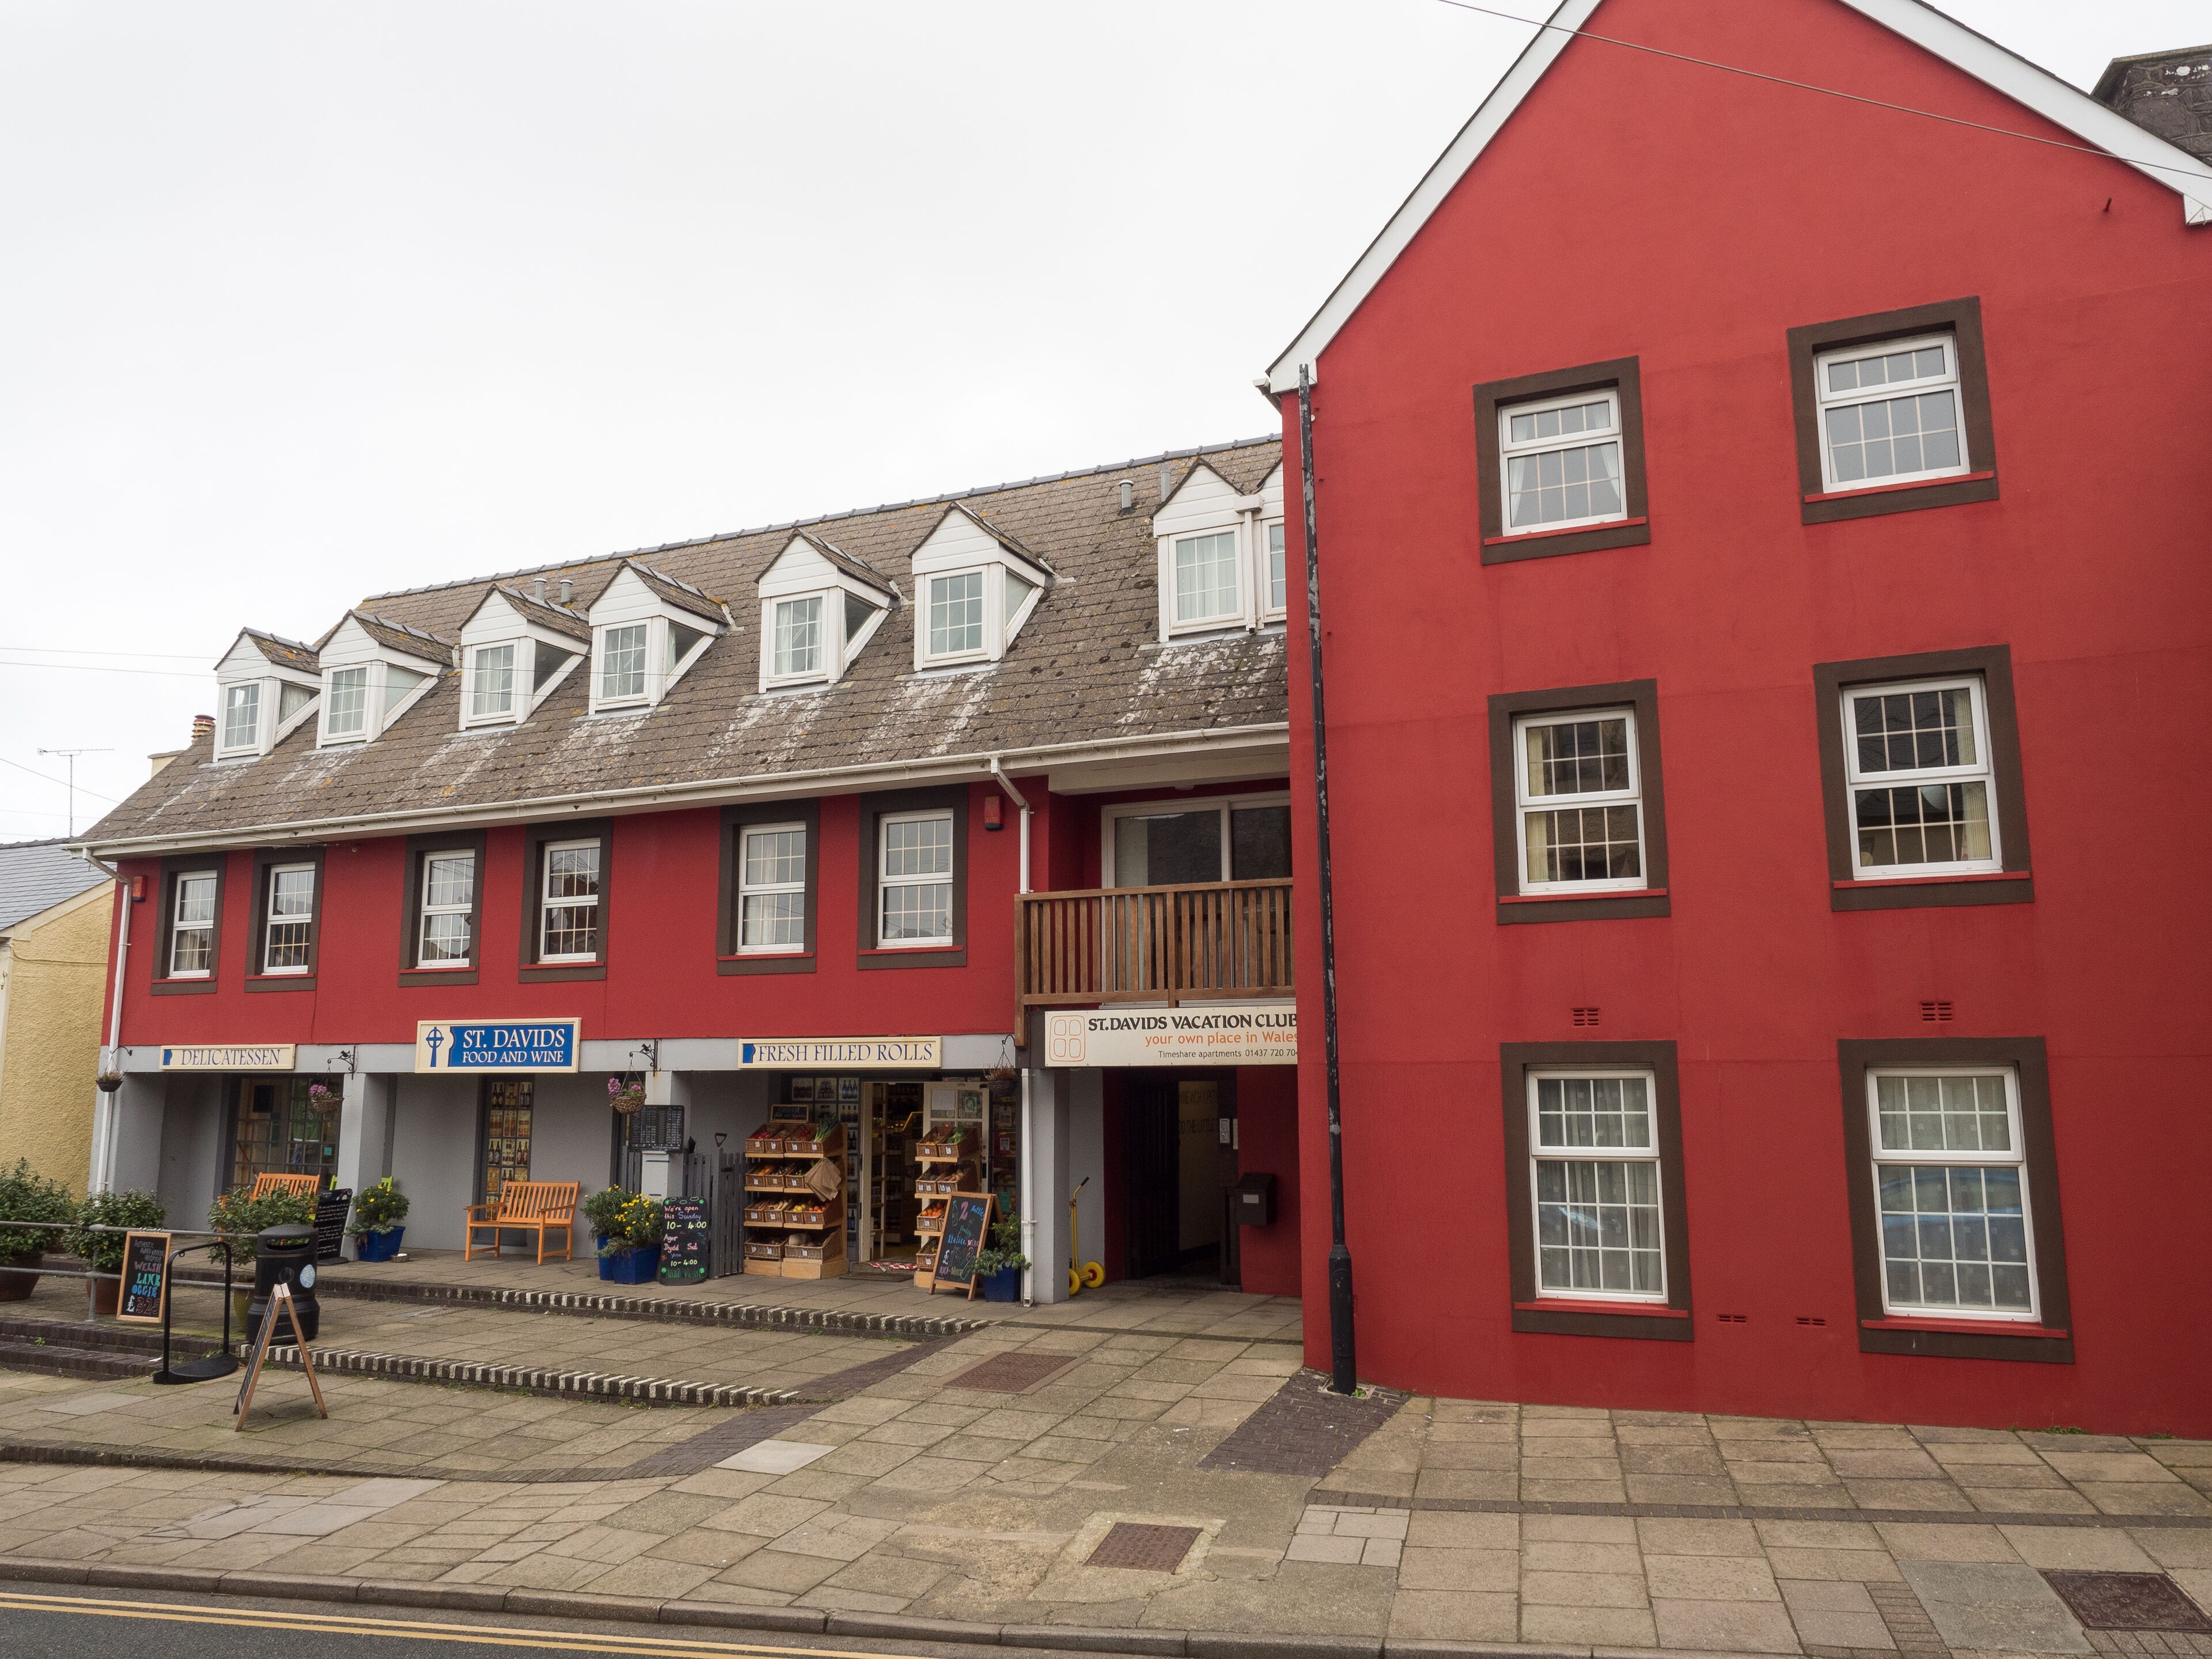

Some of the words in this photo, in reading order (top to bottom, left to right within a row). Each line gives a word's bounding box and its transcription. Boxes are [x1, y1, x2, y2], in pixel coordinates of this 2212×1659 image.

[1088, 1017, 1168, 1031] ST.DAVIDS
[1170, 1014, 1252, 1029] VACATION
[463, 1030, 487, 1048] ST.
[493, 1028, 565, 1048] DAVIDS
[1145, 1035, 1173, 1047] your
[1177, 1035, 1203, 1044] own
[1207, 1032, 1241, 1046] place
[1245, 1032, 1257, 1043] in
[181, 1049, 281, 1065] DELICATESSEN
[463, 1051, 497, 1063] FOOD
[499, 1051, 527, 1063] AND
[531, 1050, 563, 1063] WINE
[759, 1044, 808, 1061] FRESH
[815, 1044, 870, 1061] FILLED
[877, 1043, 933, 1060] ROLLS
[1198, 1050, 1241, 1059] apartments
[1245, 1049, 1267, 1057] 01437
[678, 1211, 701, 1221] Sunday
[959, 1201, 969, 1221] 2
[688, 1221, 707, 1229] 4:00
[664, 1233, 678, 1243] Agor
[134, 1261, 162, 1273] WELSH
[136, 1272, 161, 1287] LAMB
